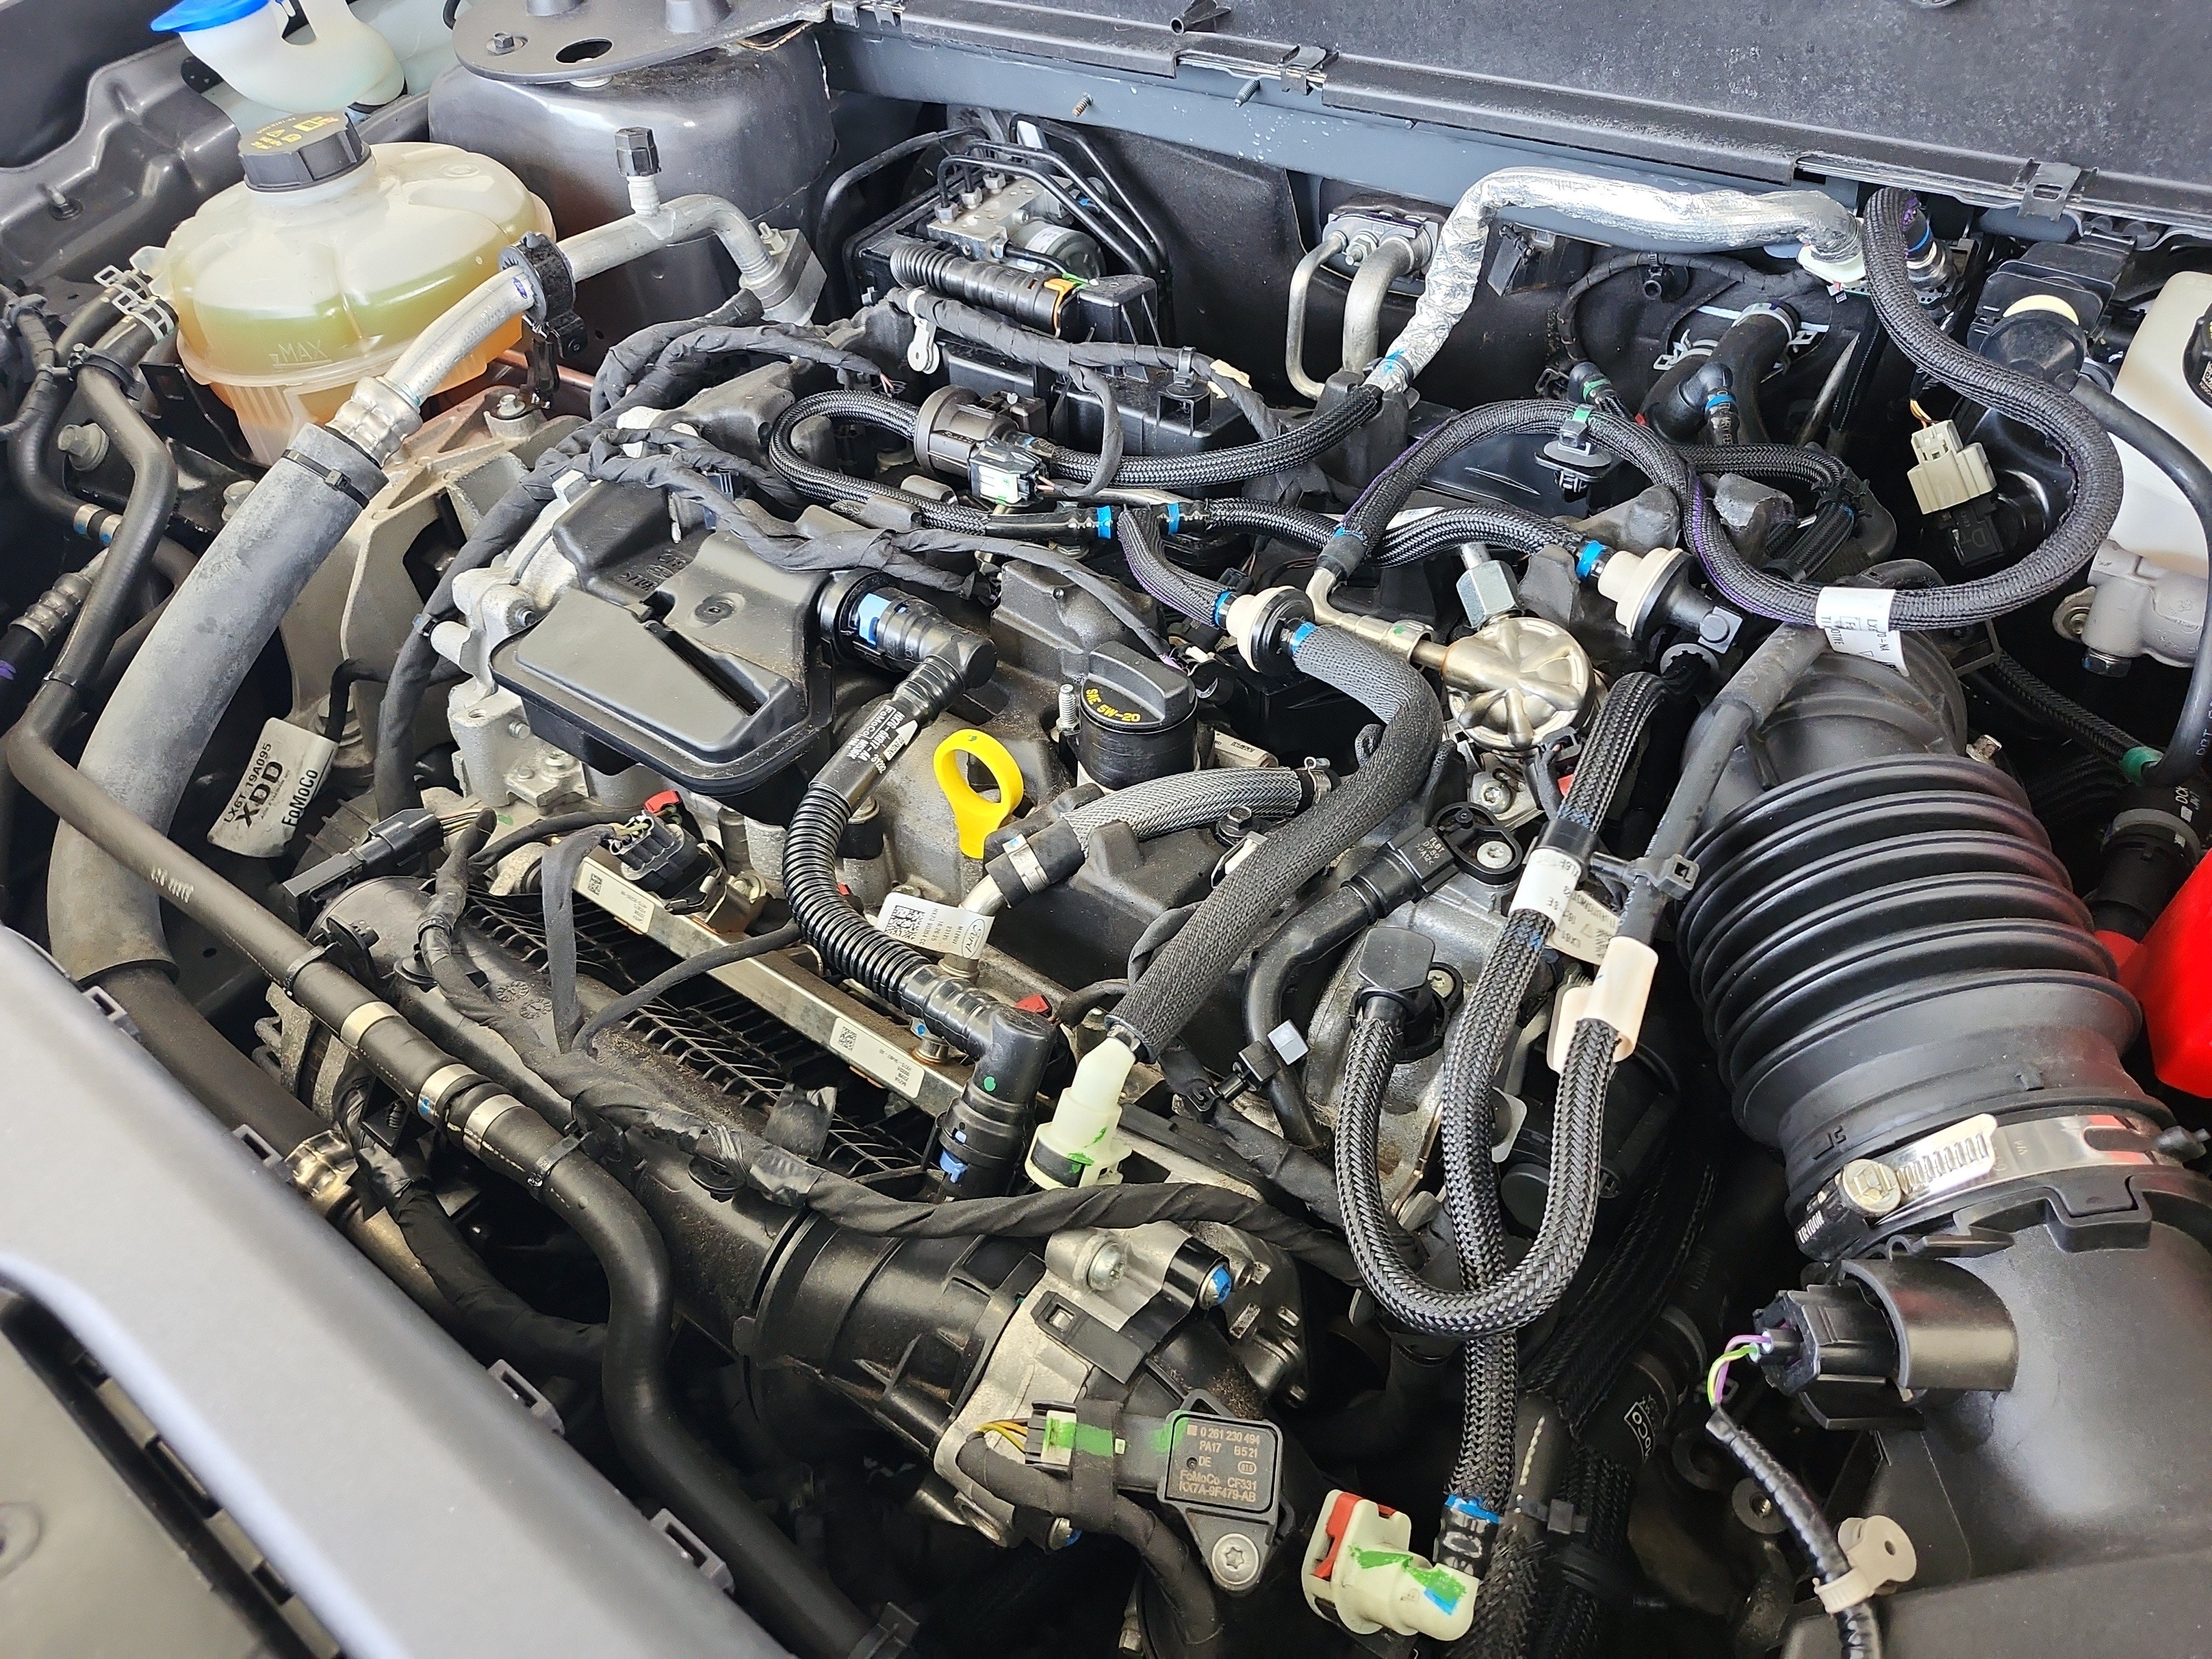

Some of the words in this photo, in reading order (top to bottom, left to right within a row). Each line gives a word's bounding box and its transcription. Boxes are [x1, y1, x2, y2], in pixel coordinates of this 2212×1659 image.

[1086, 688, 1102, 705] SAE
[1096, 704, 1141, 722] 5W-20
[863, 706, 893, 736] FoMoCo
[246, 742, 272, 788] 19A095
[235, 761, 284, 829] XDD
[281, 769, 319, 827] FoMoCo
[964, 924, 982, 953] Ford
[1797, 1210, 1825, 1244] TRIDON
[1199, 1440, 1222, 1454] PA17
[1200, 1426, 1207, 1437] 0
[1208, 1427, 1224, 1439] 261
[1226, 1430, 1243, 1443] 230
[1243, 1432, 1261, 1445] 494
[1198, 1455, 1212, 1468] DE
[1179, 1468, 1220, 1486] FoMoCo
